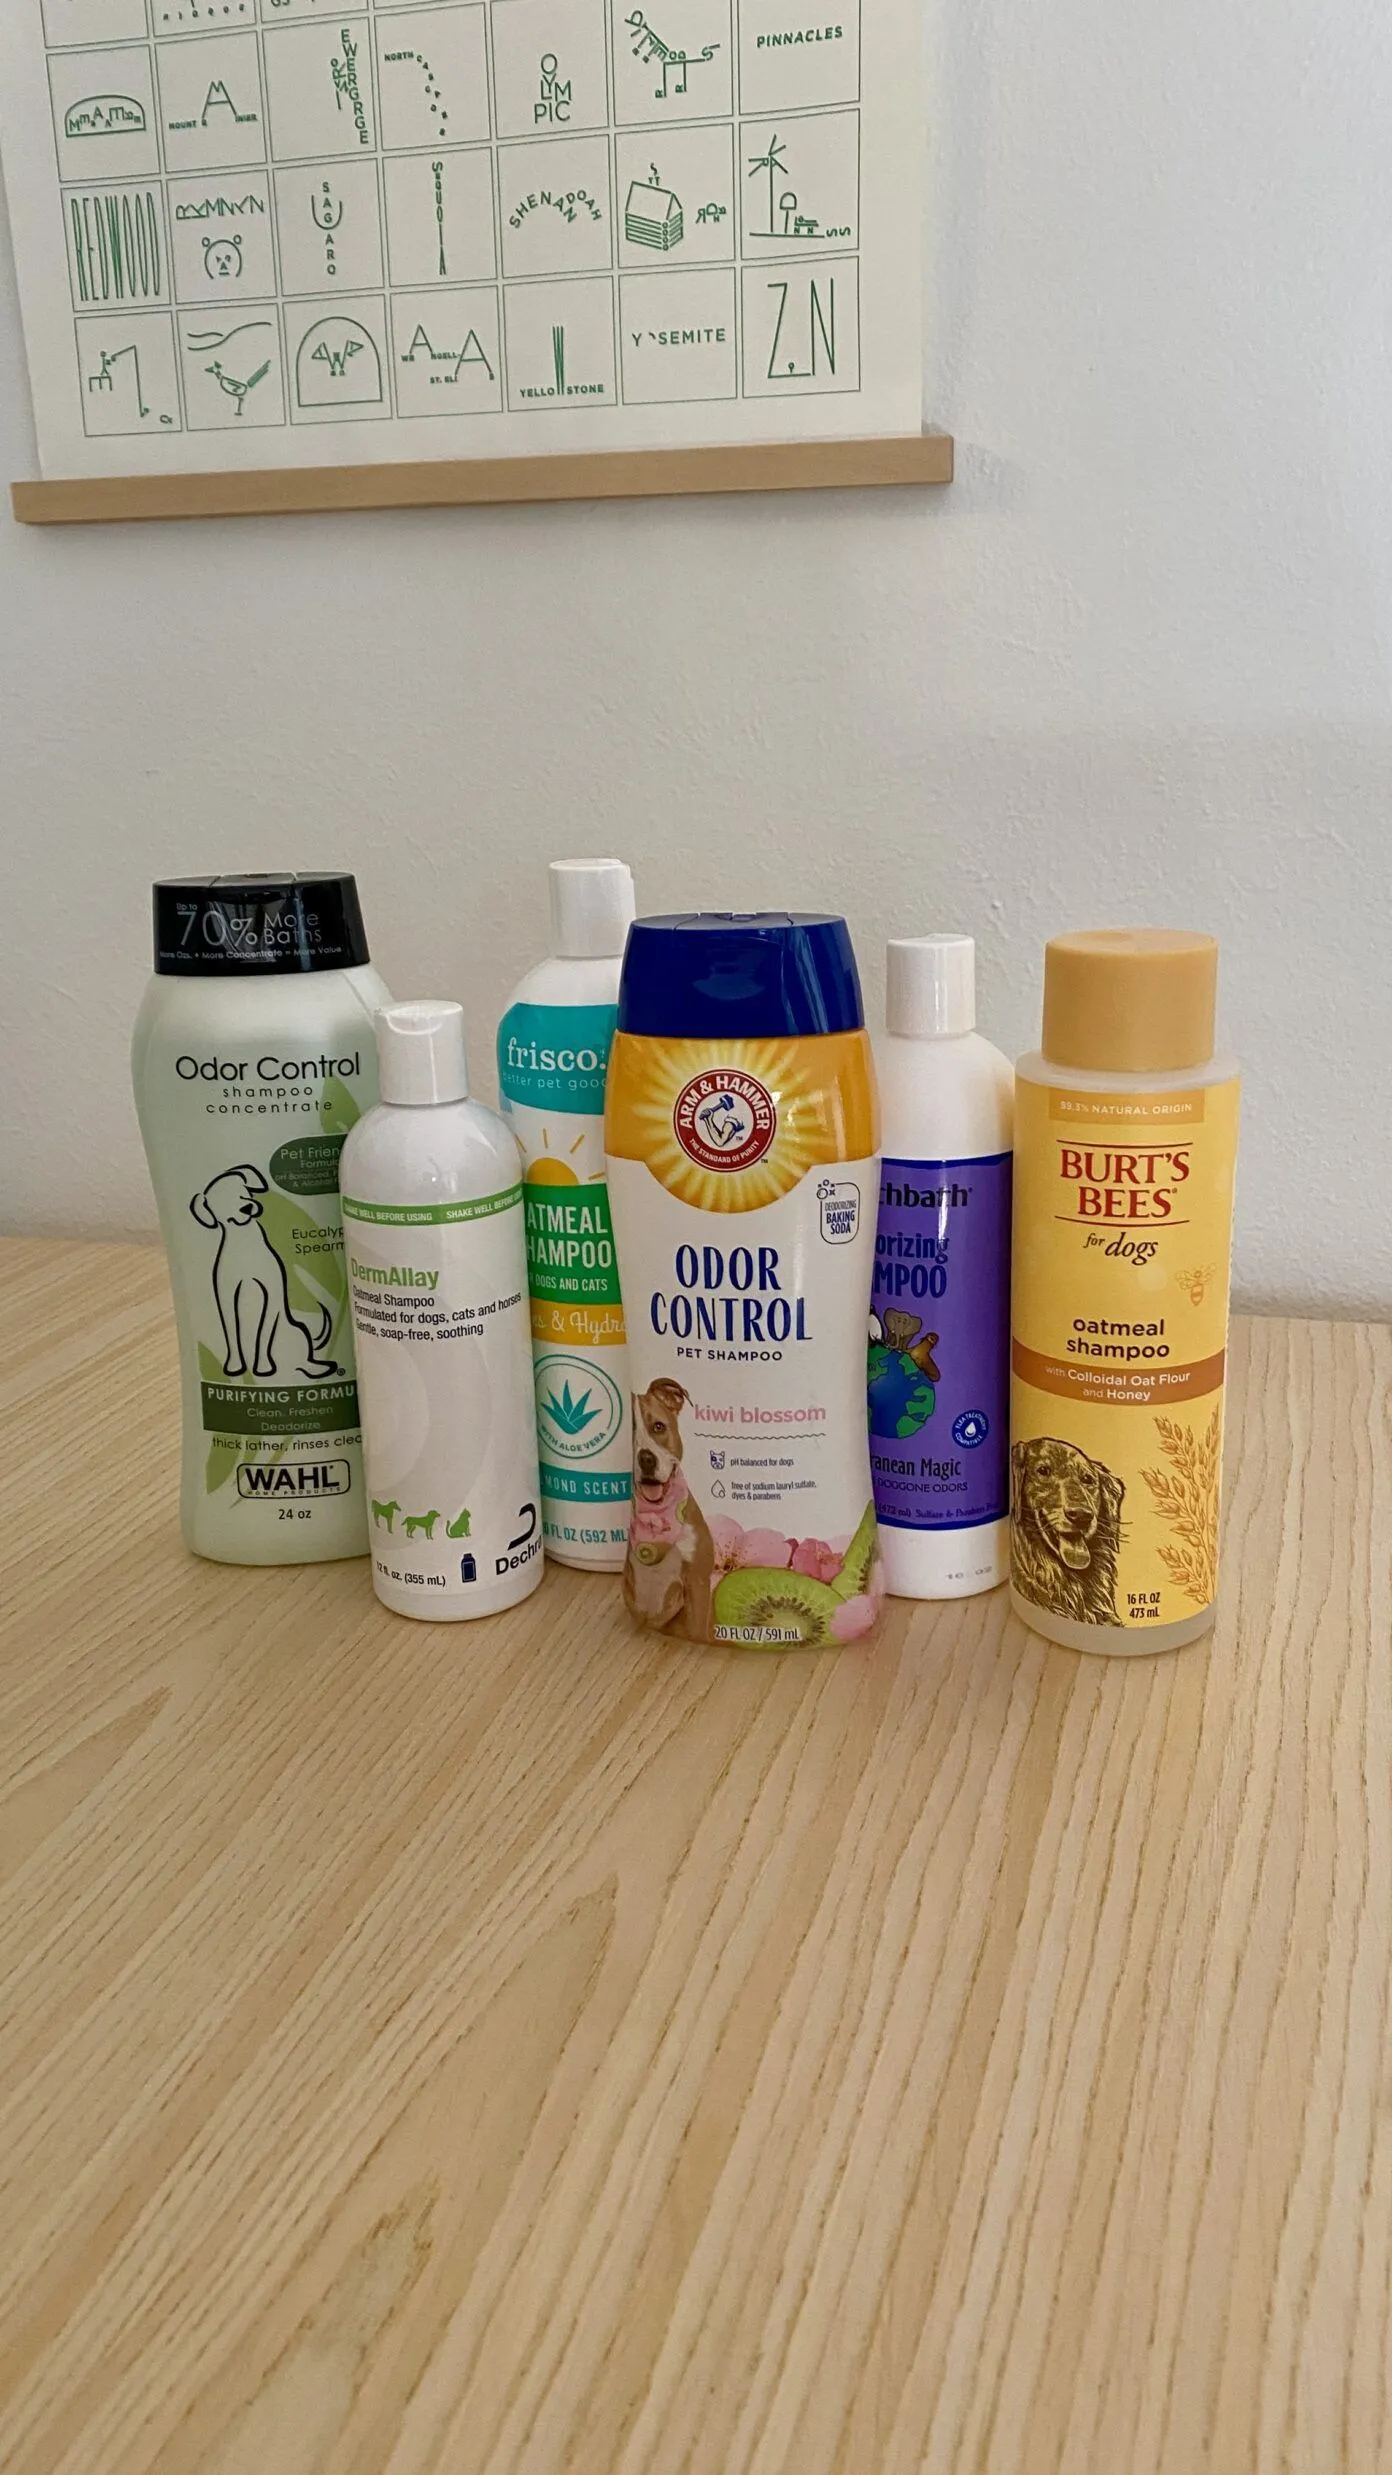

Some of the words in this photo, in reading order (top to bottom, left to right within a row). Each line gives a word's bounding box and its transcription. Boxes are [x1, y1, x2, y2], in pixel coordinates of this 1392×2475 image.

[757, 26, 843, 48] PINNACLES
[264, 912, 320, 928] More
[177, 910, 258, 947] 70%
[264, 929, 322, 944] Baths
[175, 1055, 248, 1081] Odor
[257, 1051, 360, 1080] Control
[537, 1077, 562, 1089] pet
[223, 1085, 313, 1099] shampoo
[206, 1100, 333, 1114] concentrate
[680, 1092, 701, 1128] ARM
[700, 1080, 713, 1093] &
[716, 1075, 769, 1129] HAMMER
[1092, 1104, 1149, 1115] NATURAL
[1152, 1103, 1192, 1114] ORIGIN
[281, 1148, 303, 1159] Pet
[698, 1148, 731, 1163] STANDARD
[1078, 1186, 1172, 1218] BEES
[377, 1211, 406, 1221] BEFORE
[407, 1212, 432, 1221] USING
[446, 1208, 473, 1219] SHAKE
[474, 1204, 493, 1215] WELL
[826, 1210, 855, 1224] BAKING
[830, 1222, 851, 1235] SODA
[1083, 1232, 1105, 1248] for
[1105, 1231, 1159, 1266] dogs
[351, 1258, 439, 1290] DermAllay
[675, 1244, 782, 1291] ODOR
[536, 1273, 557, 1289] DOGS
[559, 1278, 579, 1291] AND
[581, 1278, 608, 1291] CATS
[353, 1286, 381, 1304] Oatmeal
[384, 1294, 434, 1309] Shampoo
[354, 1301, 397, 1322] Formulated
[400, 1311, 413, 1323] for
[417, 1311, 449, 1325] dogs,
[452, 1308, 475, 1321] cats
[478, 1302, 496, 1316] and
[498, 1292, 521, 1310] horses
[552, 1310, 565, 1332] &
[651, 1292, 813, 1342] CONTROL
[380, 1327, 434, 1341] soap-free,
[436, 1323, 484, 1339] soothing
[1073, 1318, 1165, 1337] oatmeal
[677, 1347, 702, 1358] PET
[708, 1349, 783, 1361] SHAMPOO
[1066, 1337, 1170, 1361] shampoo
[1045, 1365, 1066, 1378] with
[1067, 1369, 1127, 1386] Colloidal
[1130, 1374, 1156, 1386] Oat
[1159, 1371, 1191, 1385] Flour
[207, 1387, 290, 1403] PURIFYING
[1083, 1387, 1104, 1398] and
[1106, 1389, 1151, 1401] Honey
[288, 1405, 334, 1417] Freshen
[694, 1404, 734, 1423] kiwi
[740, 1406, 826, 1423] blossom
[261, 1421, 321, 1432] Deodorize
[212, 1437, 242, 1450] thick
[245, 1440, 288, 1452] lather,
[292, 1438, 329, 1450] rinses
[559, 1443, 582, 1451] ALOE
[583, 1432, 607, 1449] VERA
[920, 1458, 961, 1480] Magic
[245, 1465, 340, 1491] WAHL
[583, 1481, 627, 1495] SCENT
[933, 1482, 968, 1493] ODORS
[278, 1508, 294, 1520] 24
[298, 1510, 311, 1519] oz
[550, 1523, 562, 1539] FL
[564, 1528, 576, 1541] OZ
[580, 1528, 607, 1544] (592
[391, 1571, 402, 1581] oz.
[404, 1573, 425, 1585] (355
[426, 1575, 446, 1587] mL)
[1127, 1593, 1136, 1604] 16
[1138, 1593, 1148, 1604] FL
[1149, 1592, 1161, 1604] OZ
[1129, 1608, 1145, 1618] 473
[1146, 1607, 1160, 1618] mL
[716, 1626, 728, 1638] 20
[730, 1627, 740, 1639] FL
[742, 1627, 755, 1640] OZ
[765, 1627, 782, 1640] 591
[784, 1628, 800, 1640] mL
